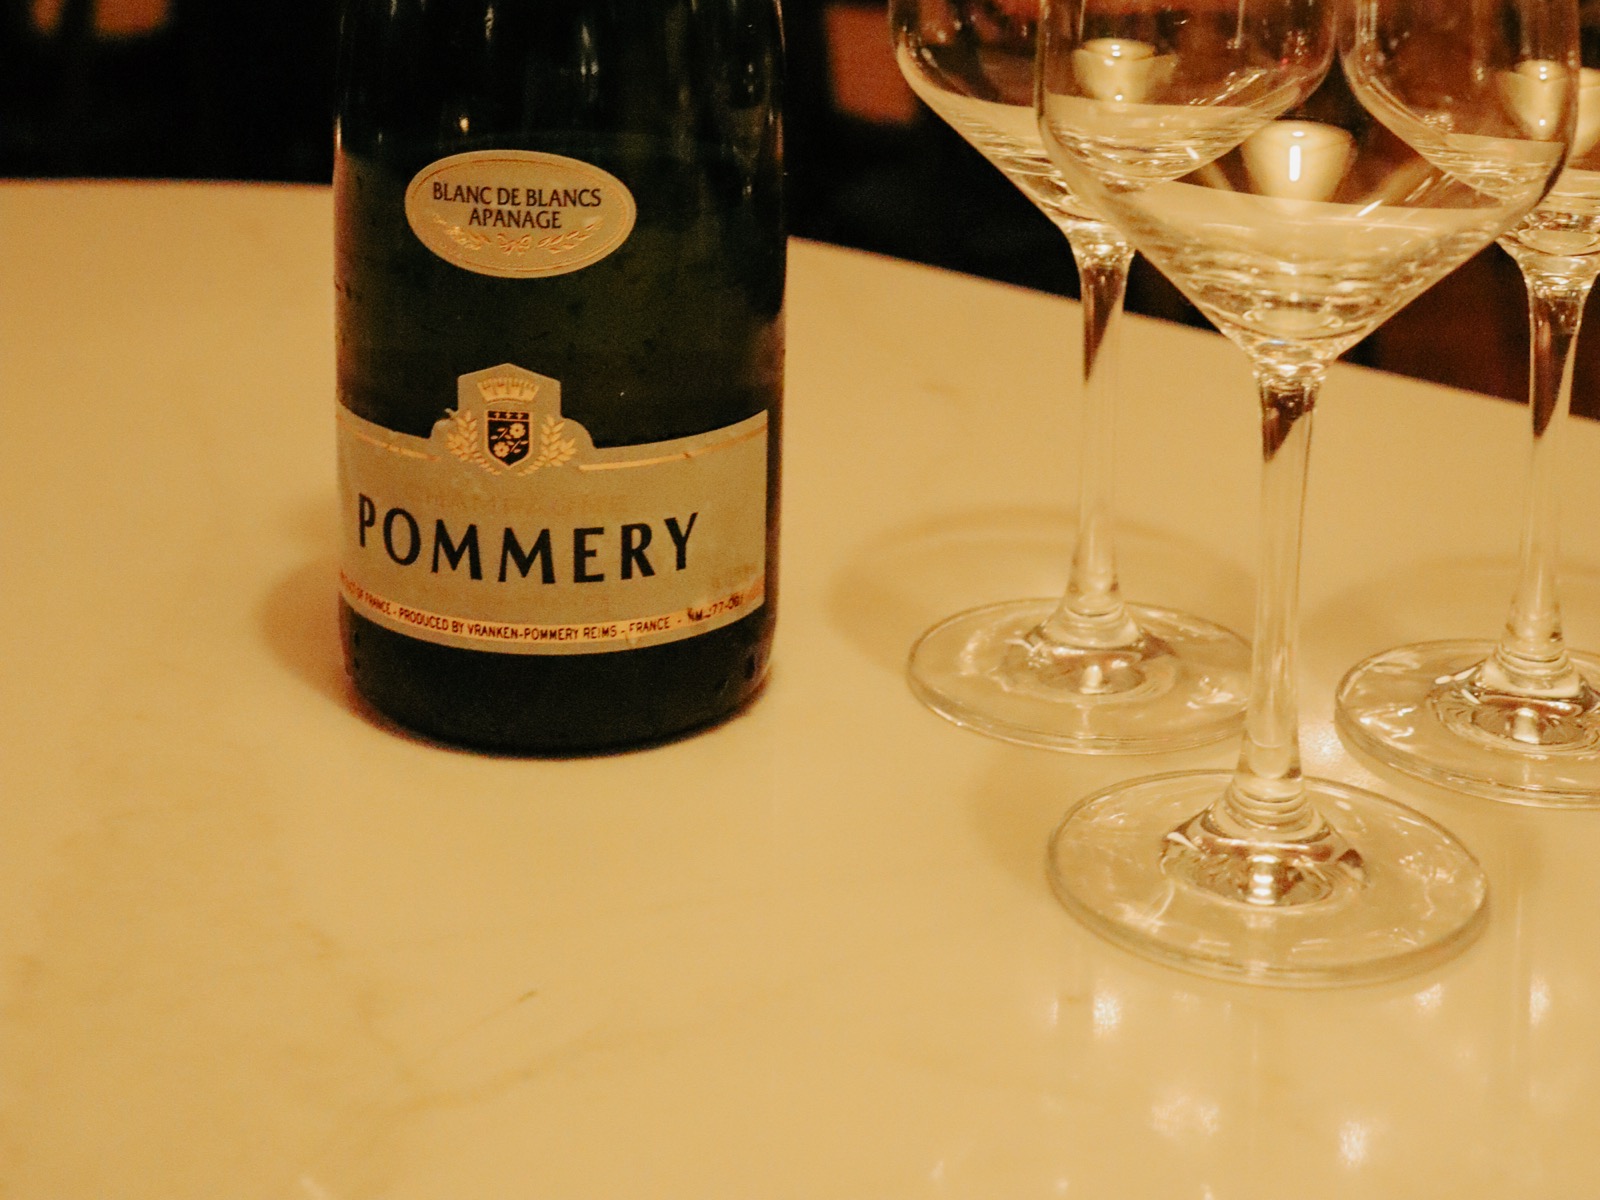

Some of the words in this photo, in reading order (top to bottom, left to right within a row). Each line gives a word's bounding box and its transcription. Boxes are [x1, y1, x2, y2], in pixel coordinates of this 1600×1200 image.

[433, 182, 492, 205] BLANC
[497, 187, 520, 207] DE
[526, 188, 602, 207] BLANCS
[469, 208, 562, 229] APANAGE
[358, 493, 699, 585] POMMERY
[399, 607, 448, 631] PRODUCED
[452, 620, 464, 634] BY
[467, 625, 578, 641] VRANKEN-POMMERY
[584, 625, 617, 639] REIMS
[629, 617, 670, 633] FRANCE
